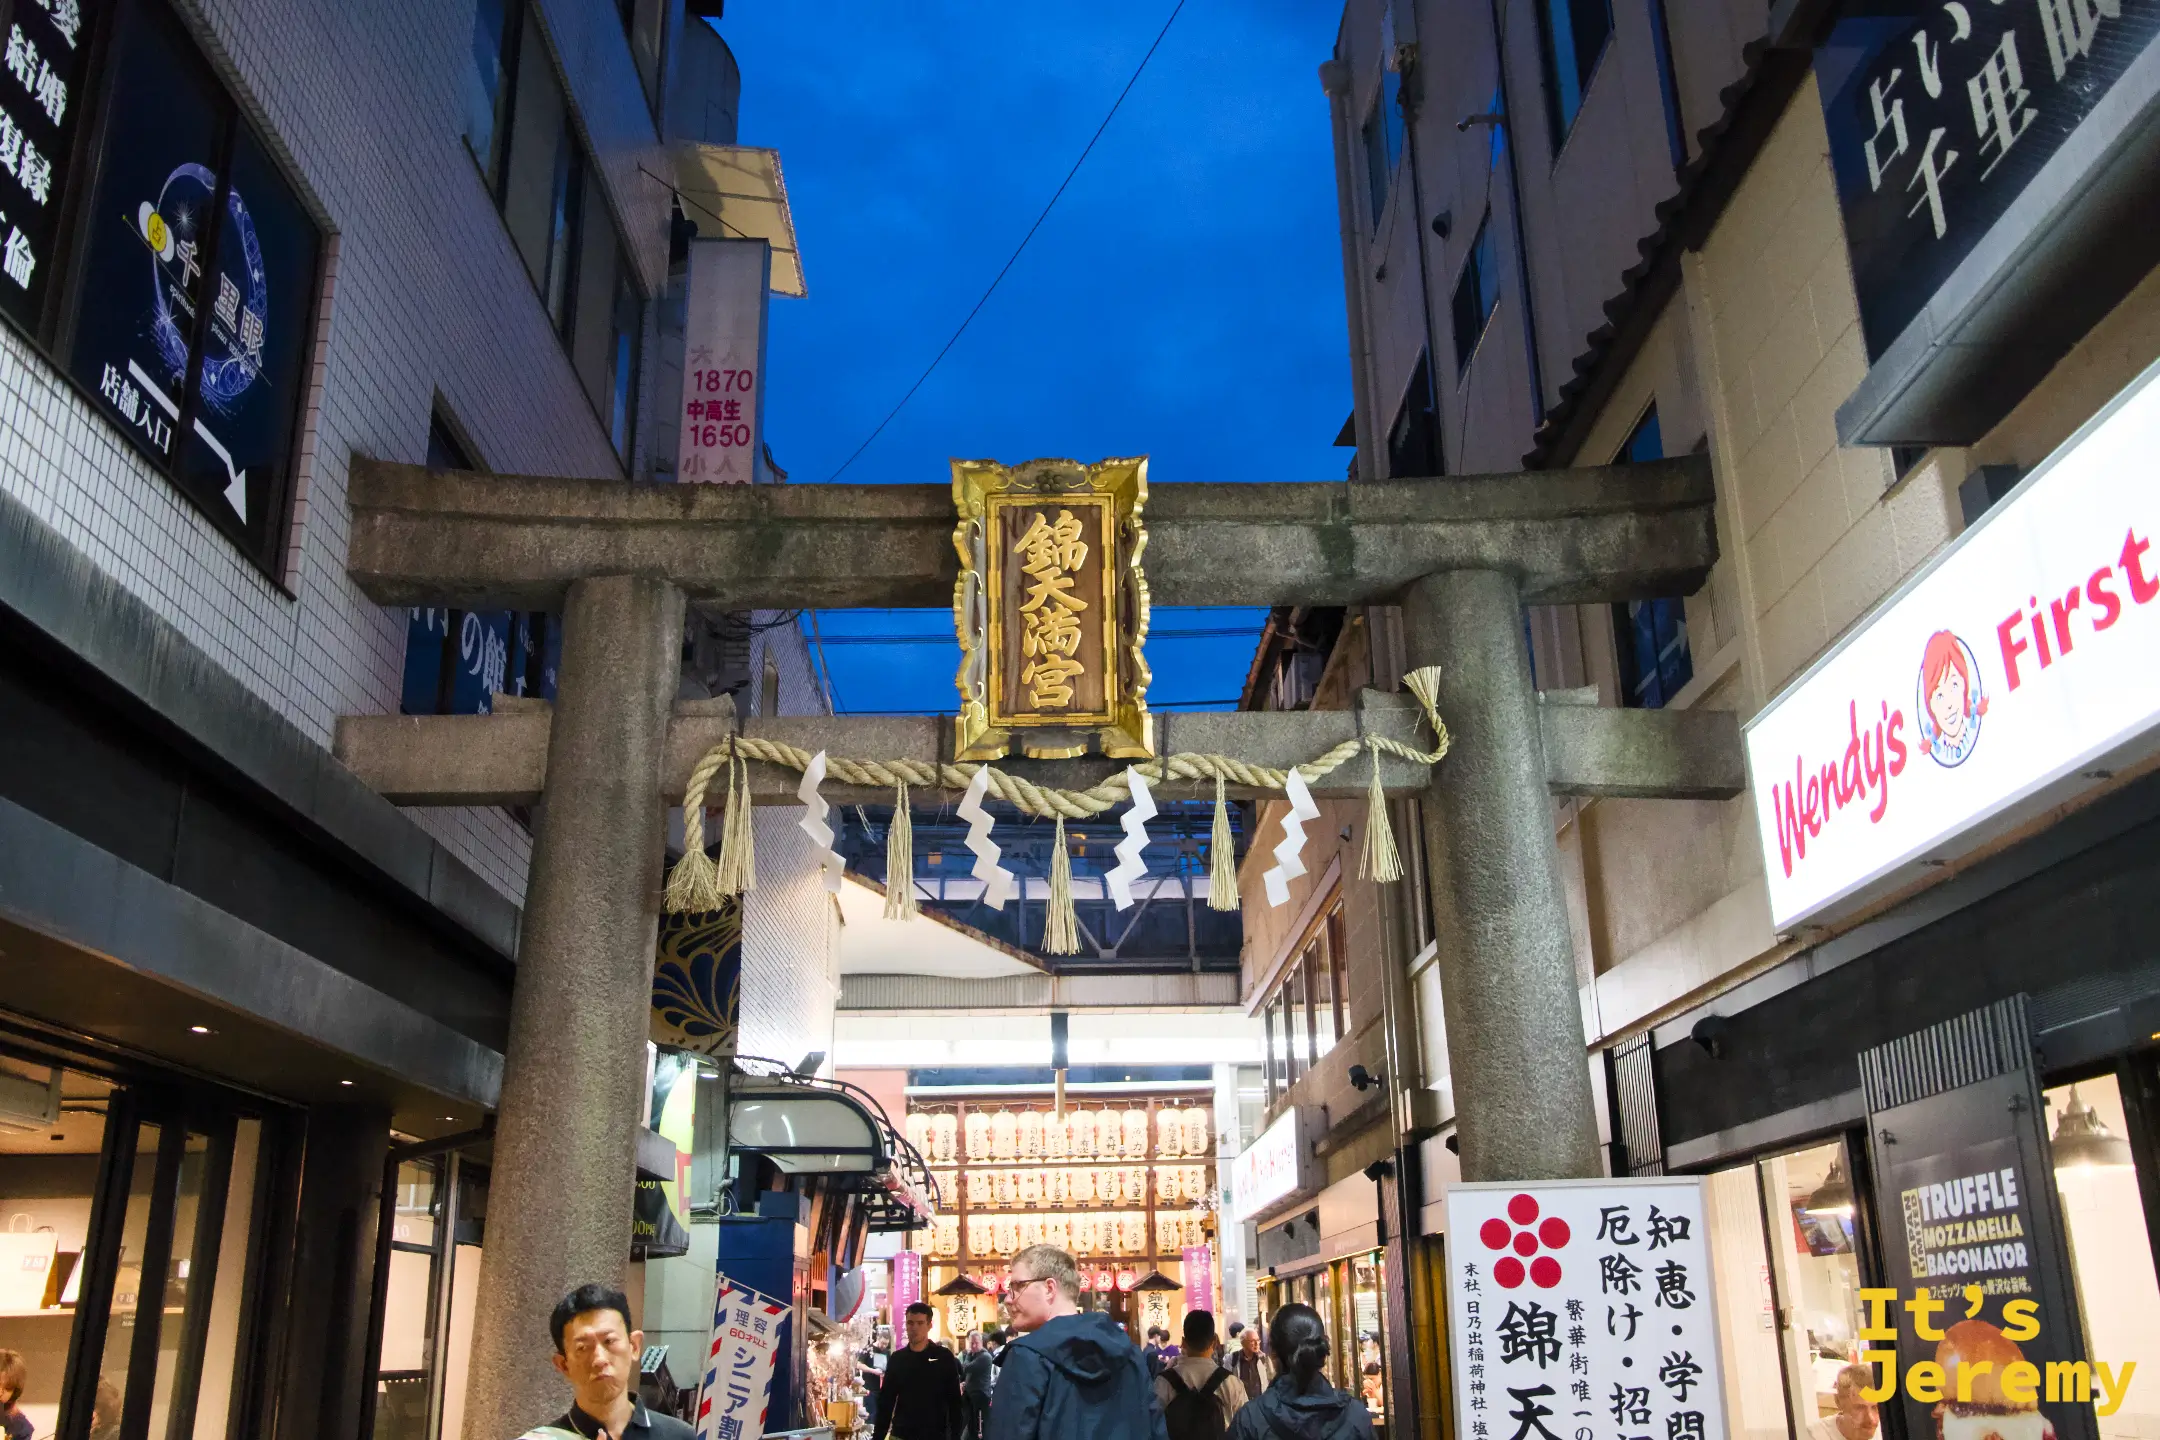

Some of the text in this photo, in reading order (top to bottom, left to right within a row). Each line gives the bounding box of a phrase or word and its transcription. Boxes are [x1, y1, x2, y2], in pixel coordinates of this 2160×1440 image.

[5, 23, 68, 127] 結婚
[176, 239, 266, 369] 千里眼
[99, 362, 173, 455] 店舗入口
[687, 399, 741, 422] 中高生
[693, 369, 753, 393] 1870
[690, 424, 751, 448] 1650
[1013, 509, 1088, 709] 錦天満宮
[1772, 526, 2160, 879] Wendy's First
[1911, 1194, 1926, 1272] LIMITED
[1918, 1167, 2019, 1222] TRUFFLE
[1923, 1213, 2024, 1249] MOZZARELLA
[1904, 1195, 1919, 1276] JAPAN
[1927, 1242, 2028, 1276] BACONATOR
[729, 1327, 768, 1350] 60才以上
[733, 1307, 768, 1335] 理容
[1464, 1262, 1489, 1440] 末社、日乃出稲荷神社・塩
[1596, 1205, 1653, 1440] 厄除け・招
[718, 1346, 757, 1440] シニア割
[1496, 1300, 1564, 1440] 錦天
